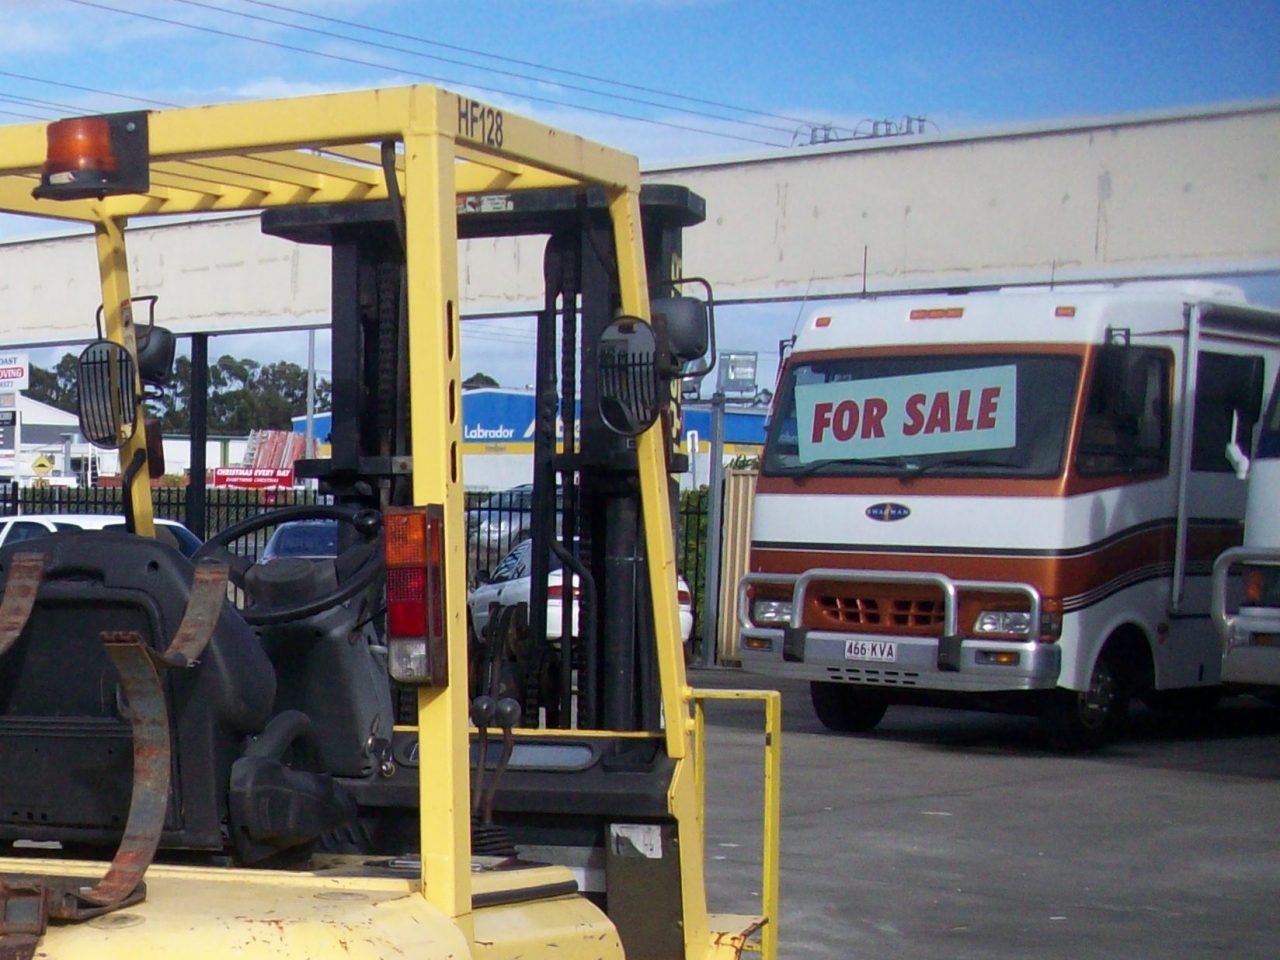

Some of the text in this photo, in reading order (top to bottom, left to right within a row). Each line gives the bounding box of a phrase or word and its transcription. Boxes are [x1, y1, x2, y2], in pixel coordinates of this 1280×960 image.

[457, 94, 504, 149] HF128
[464, 424, 514, 439] Labrador
[811, 386, 1001, 443] FOR SALE
[216, 469, 291, 477] CHRISTMAS EVERY DAY
